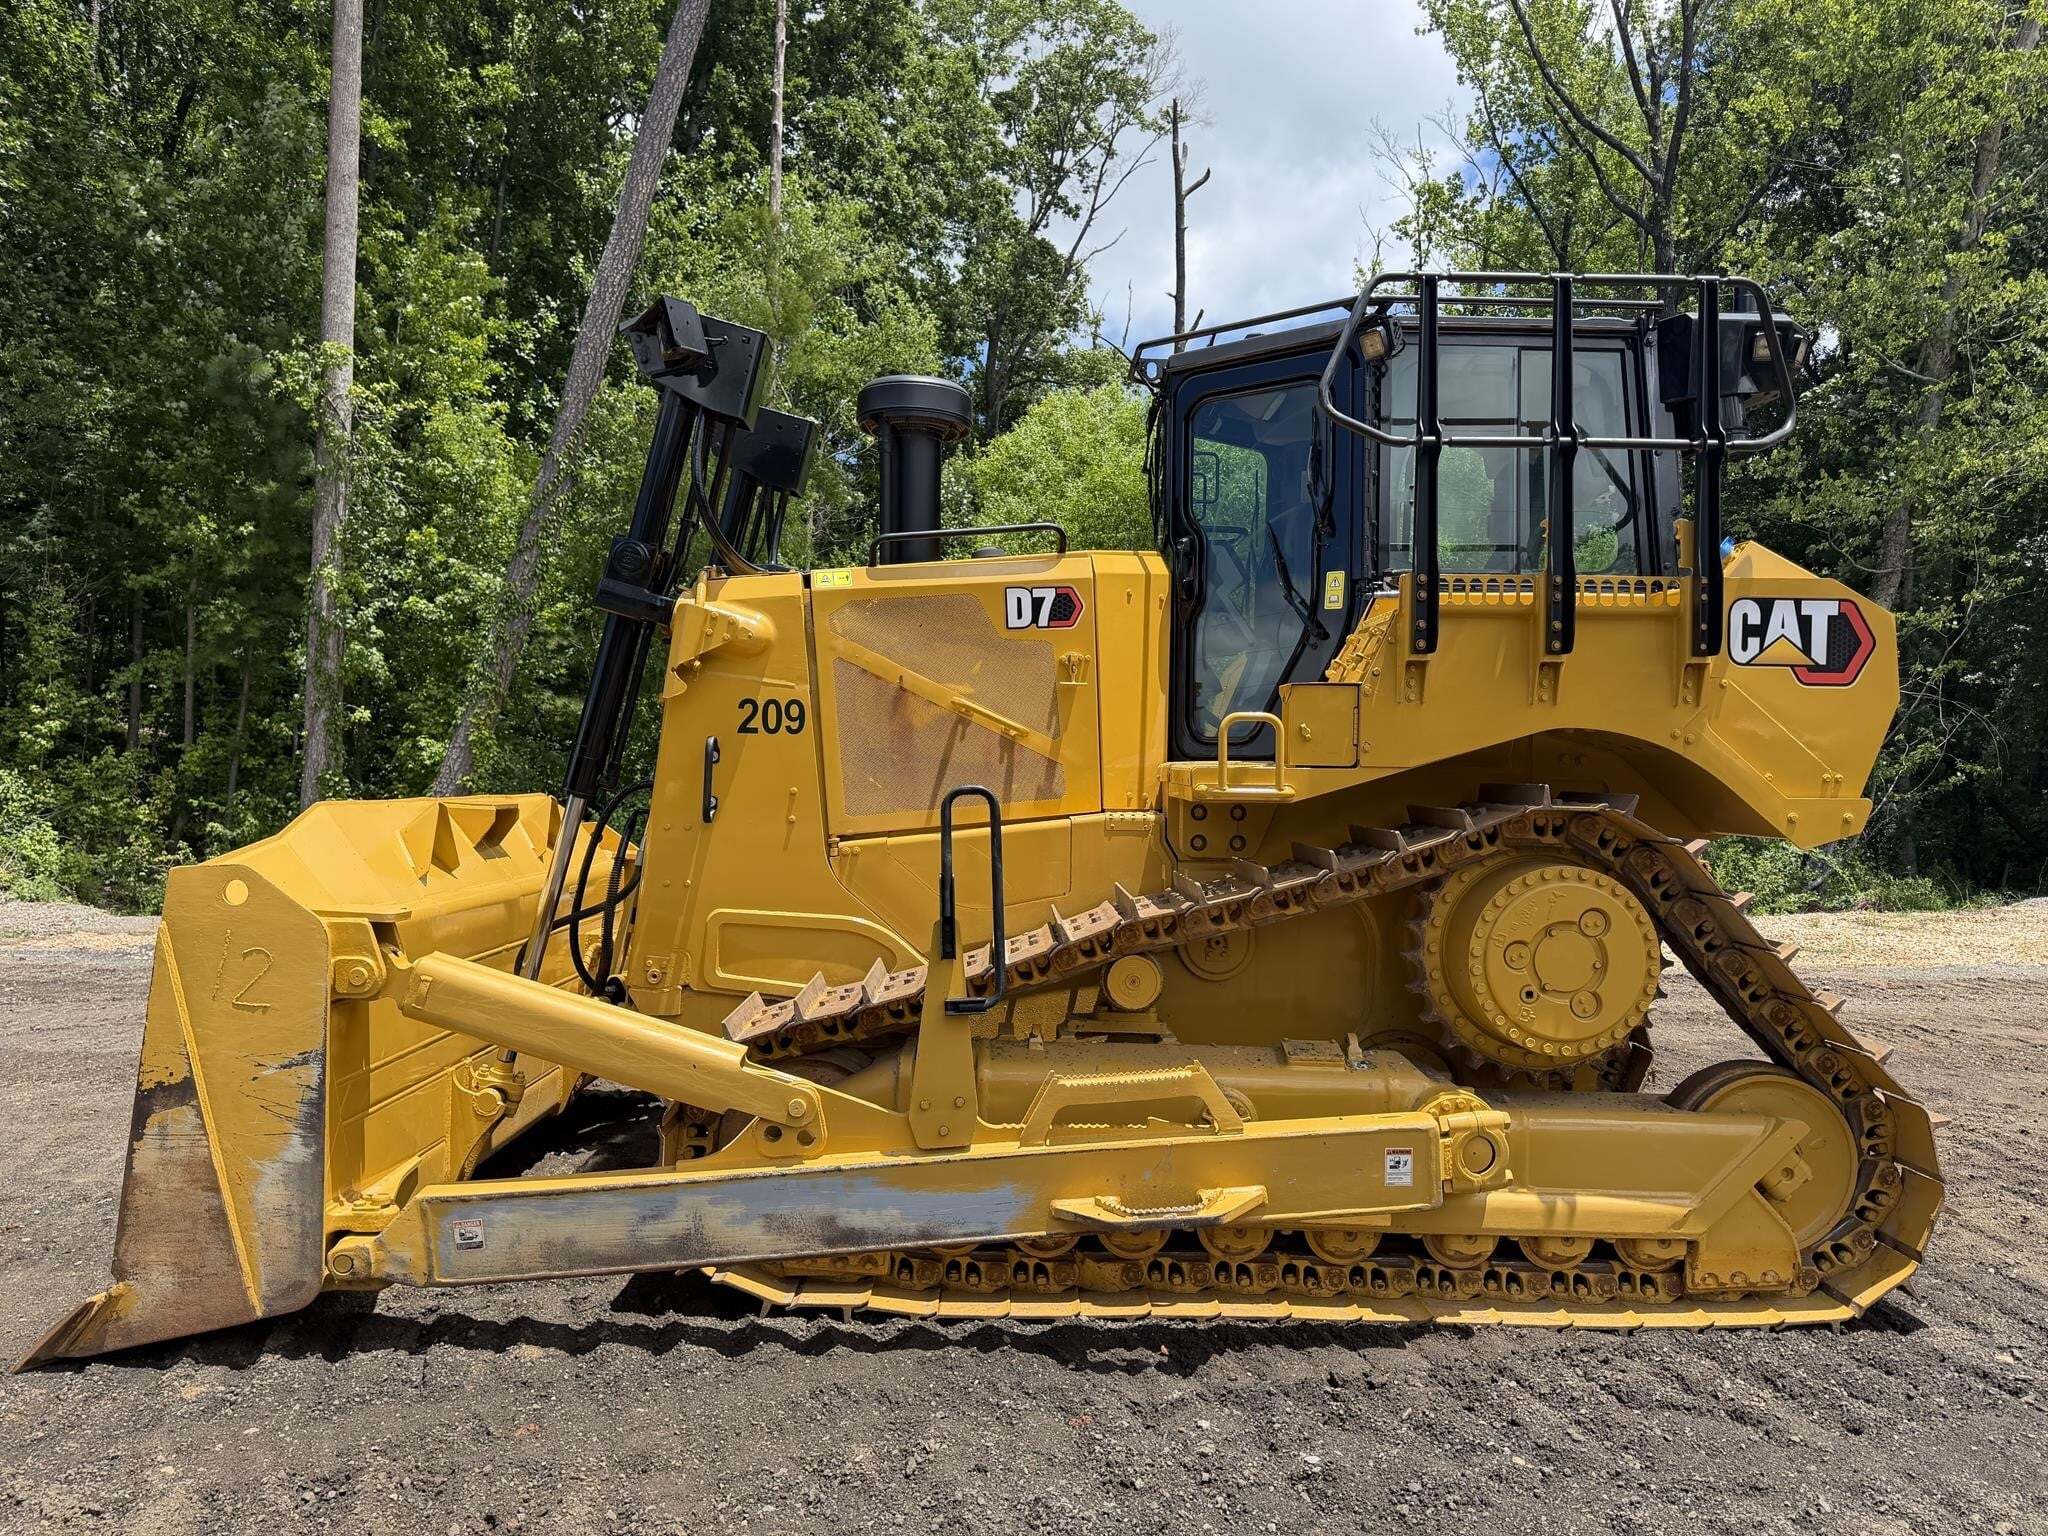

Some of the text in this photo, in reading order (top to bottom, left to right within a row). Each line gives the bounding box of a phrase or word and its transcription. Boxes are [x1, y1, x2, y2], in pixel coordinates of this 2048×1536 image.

[1006, 588, 1056, 627] D7
[1730, 599, 1839, 665] CAT
[737, 698, 806, 735] 209
[211, 929, 273, 1010] 12
